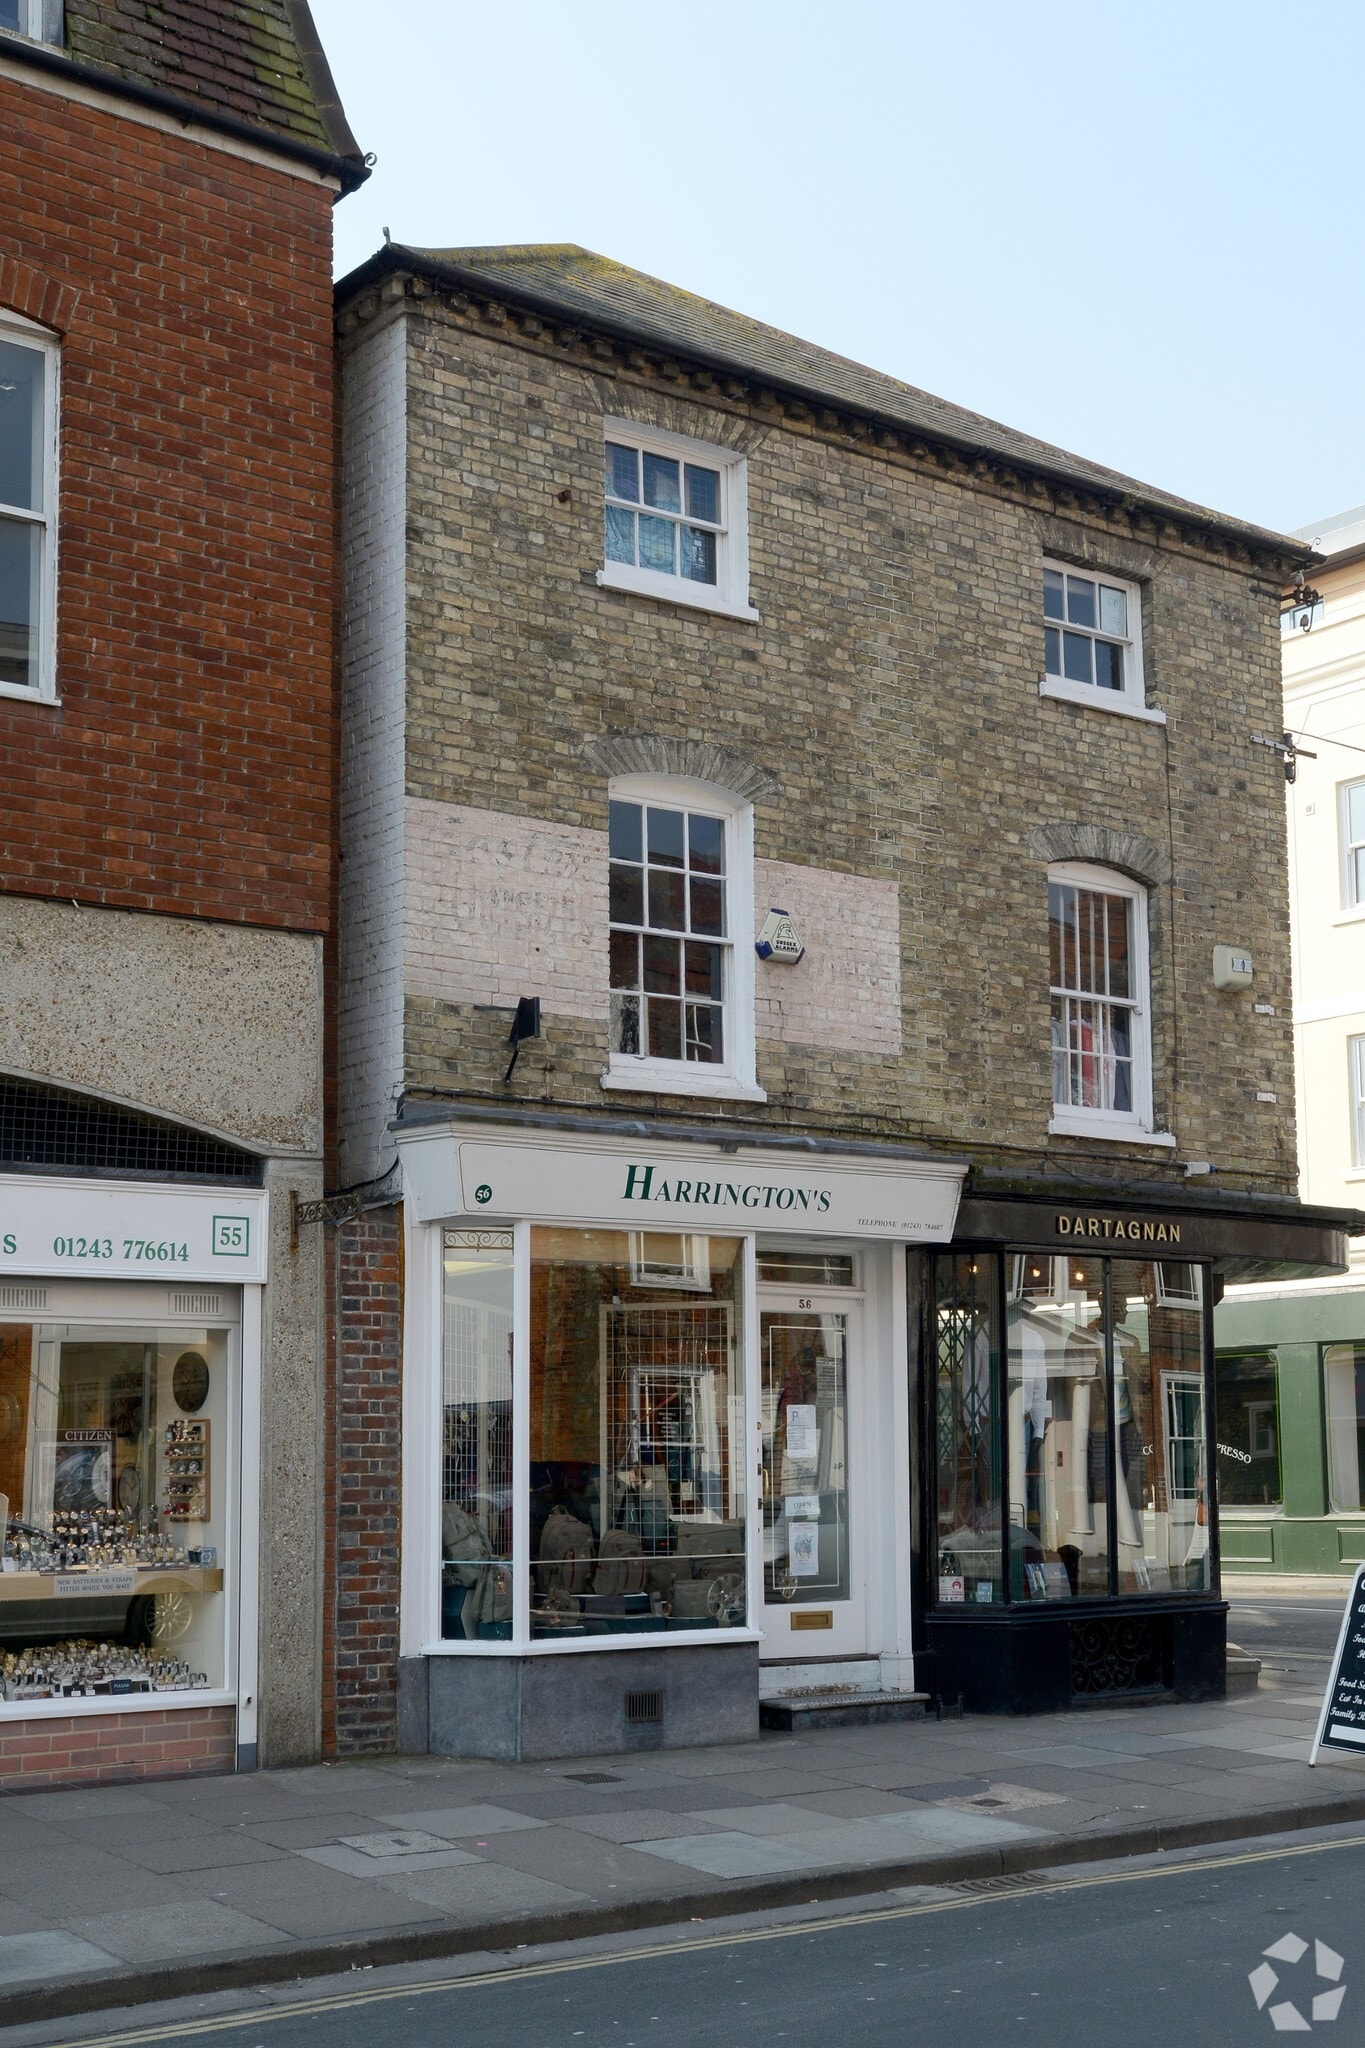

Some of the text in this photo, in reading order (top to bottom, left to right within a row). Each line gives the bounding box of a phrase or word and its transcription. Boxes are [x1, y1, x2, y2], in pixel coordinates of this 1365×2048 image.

[476, 1188, 490, 1201] 56
[621, 1164, 831, 1212] HARRINGTON'S
[857, 1218, 897, 1228] TELEPHONE
[1058, 1215, 1180, 1242] DARTAGNAN
[220, 1226, 242, 1246] 55
[3, 1233, 189, 1262] S 01243 776614
[799, 1299, 811, 1310] 56
[65, 1430, 113, 1441] CITIZEN
[793, 1501, 811, 1510] OPEN
[1338, 1677, 1358, 1688] Food
[1338, 1692, 1352, 1703] Eat
[1352, 1694, 1363, 1705] In
[1329, 1706, 1356, 1722] Family
